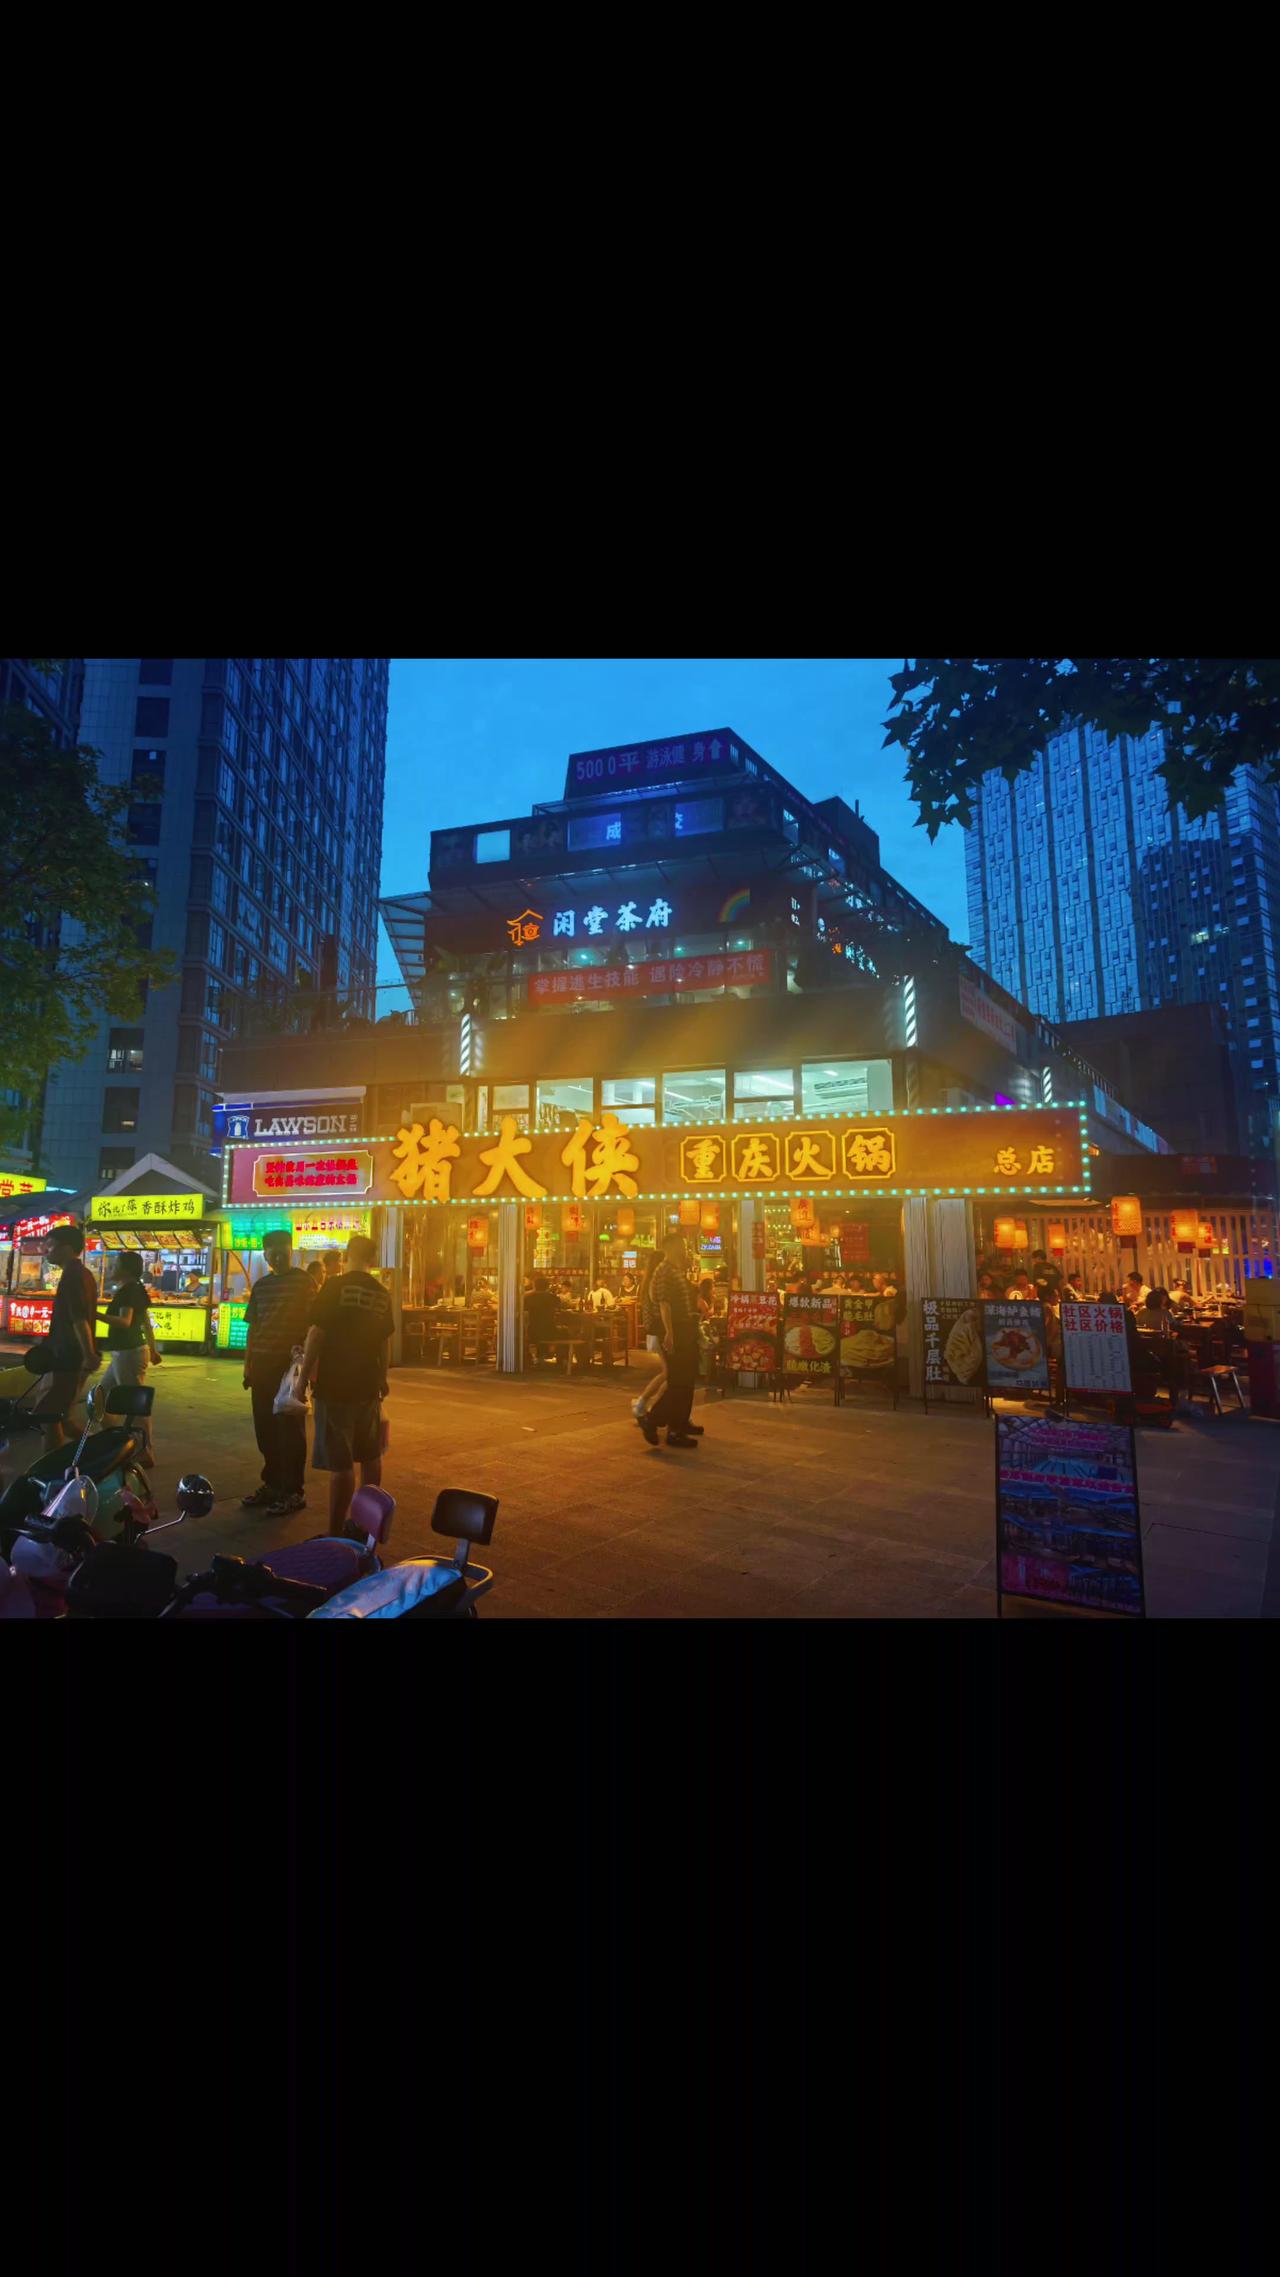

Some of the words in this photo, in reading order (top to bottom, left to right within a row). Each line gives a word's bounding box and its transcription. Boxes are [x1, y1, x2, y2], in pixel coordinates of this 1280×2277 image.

[553, 898, 673, 937] 闲堂茶府
[254, 1116, 347, 1136] LAWSON
[391, 1118, 640, 1202] 猪大侠
[685, 1135, 892, 1180] 重庆火锅
[993, 1147, 1056, 1176] 总店
[142, 1199, 194, 1215] 香酥炸鸡
[1063, 1305, 1122, 1319] 社区火锅
[1065, 1320, 1123, 1335] 社区价格
